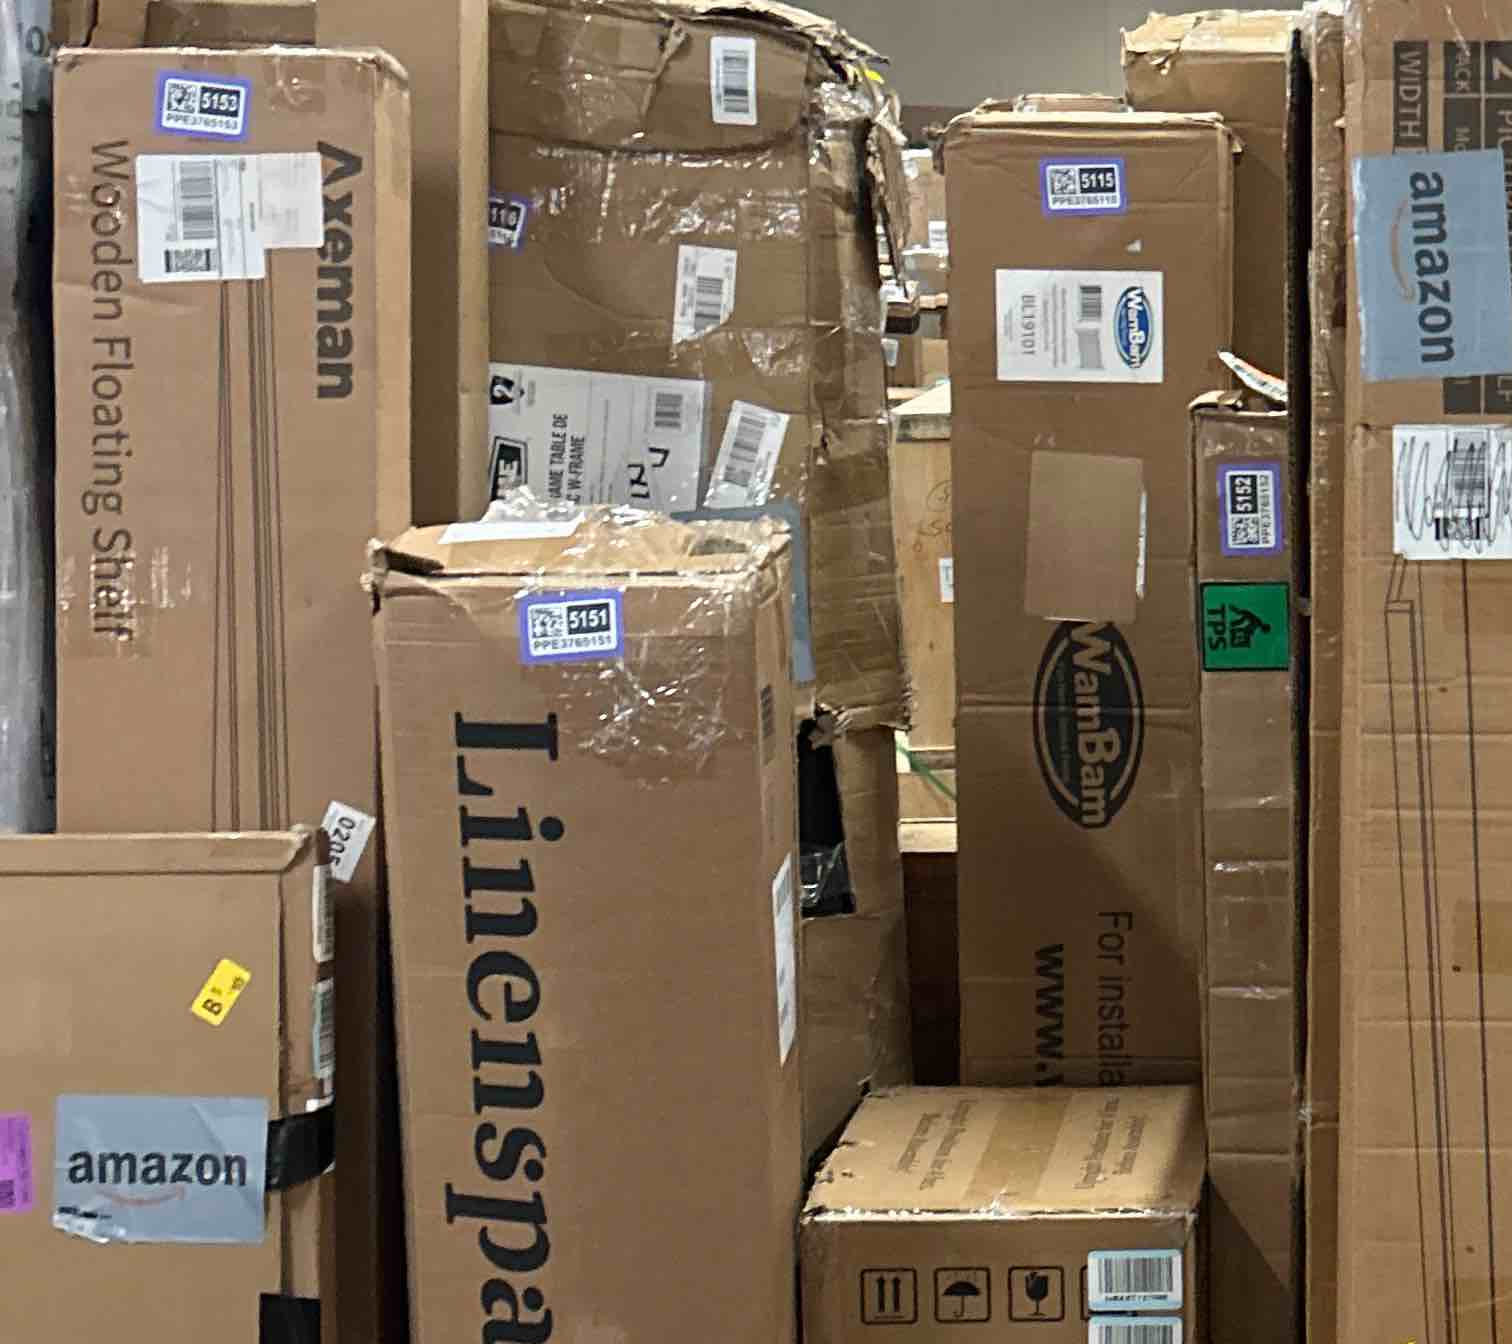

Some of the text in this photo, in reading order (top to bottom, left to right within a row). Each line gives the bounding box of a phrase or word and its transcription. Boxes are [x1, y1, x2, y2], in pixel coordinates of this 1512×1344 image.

[201, 89, 238, 112] 5153
[1400, 51, 1422, 138] WIDTH
[1081, 173, 1115, 188] 5115
[316, 140, 363, 399] Axeman
[1409, 171, 1457, 364] amazon
[81, 140, 134, 642] Wooden Floating Shelf
[1235, 476, 1253, 513] 5152
[569, 608, 608, 630] 5151
[1206, 602, 1227, 651] TPS
[1069, 621, 1121, 825] WamBam
[1097, 911, 1133, 965] For
[67, 1145, 249, 1188] amazon
